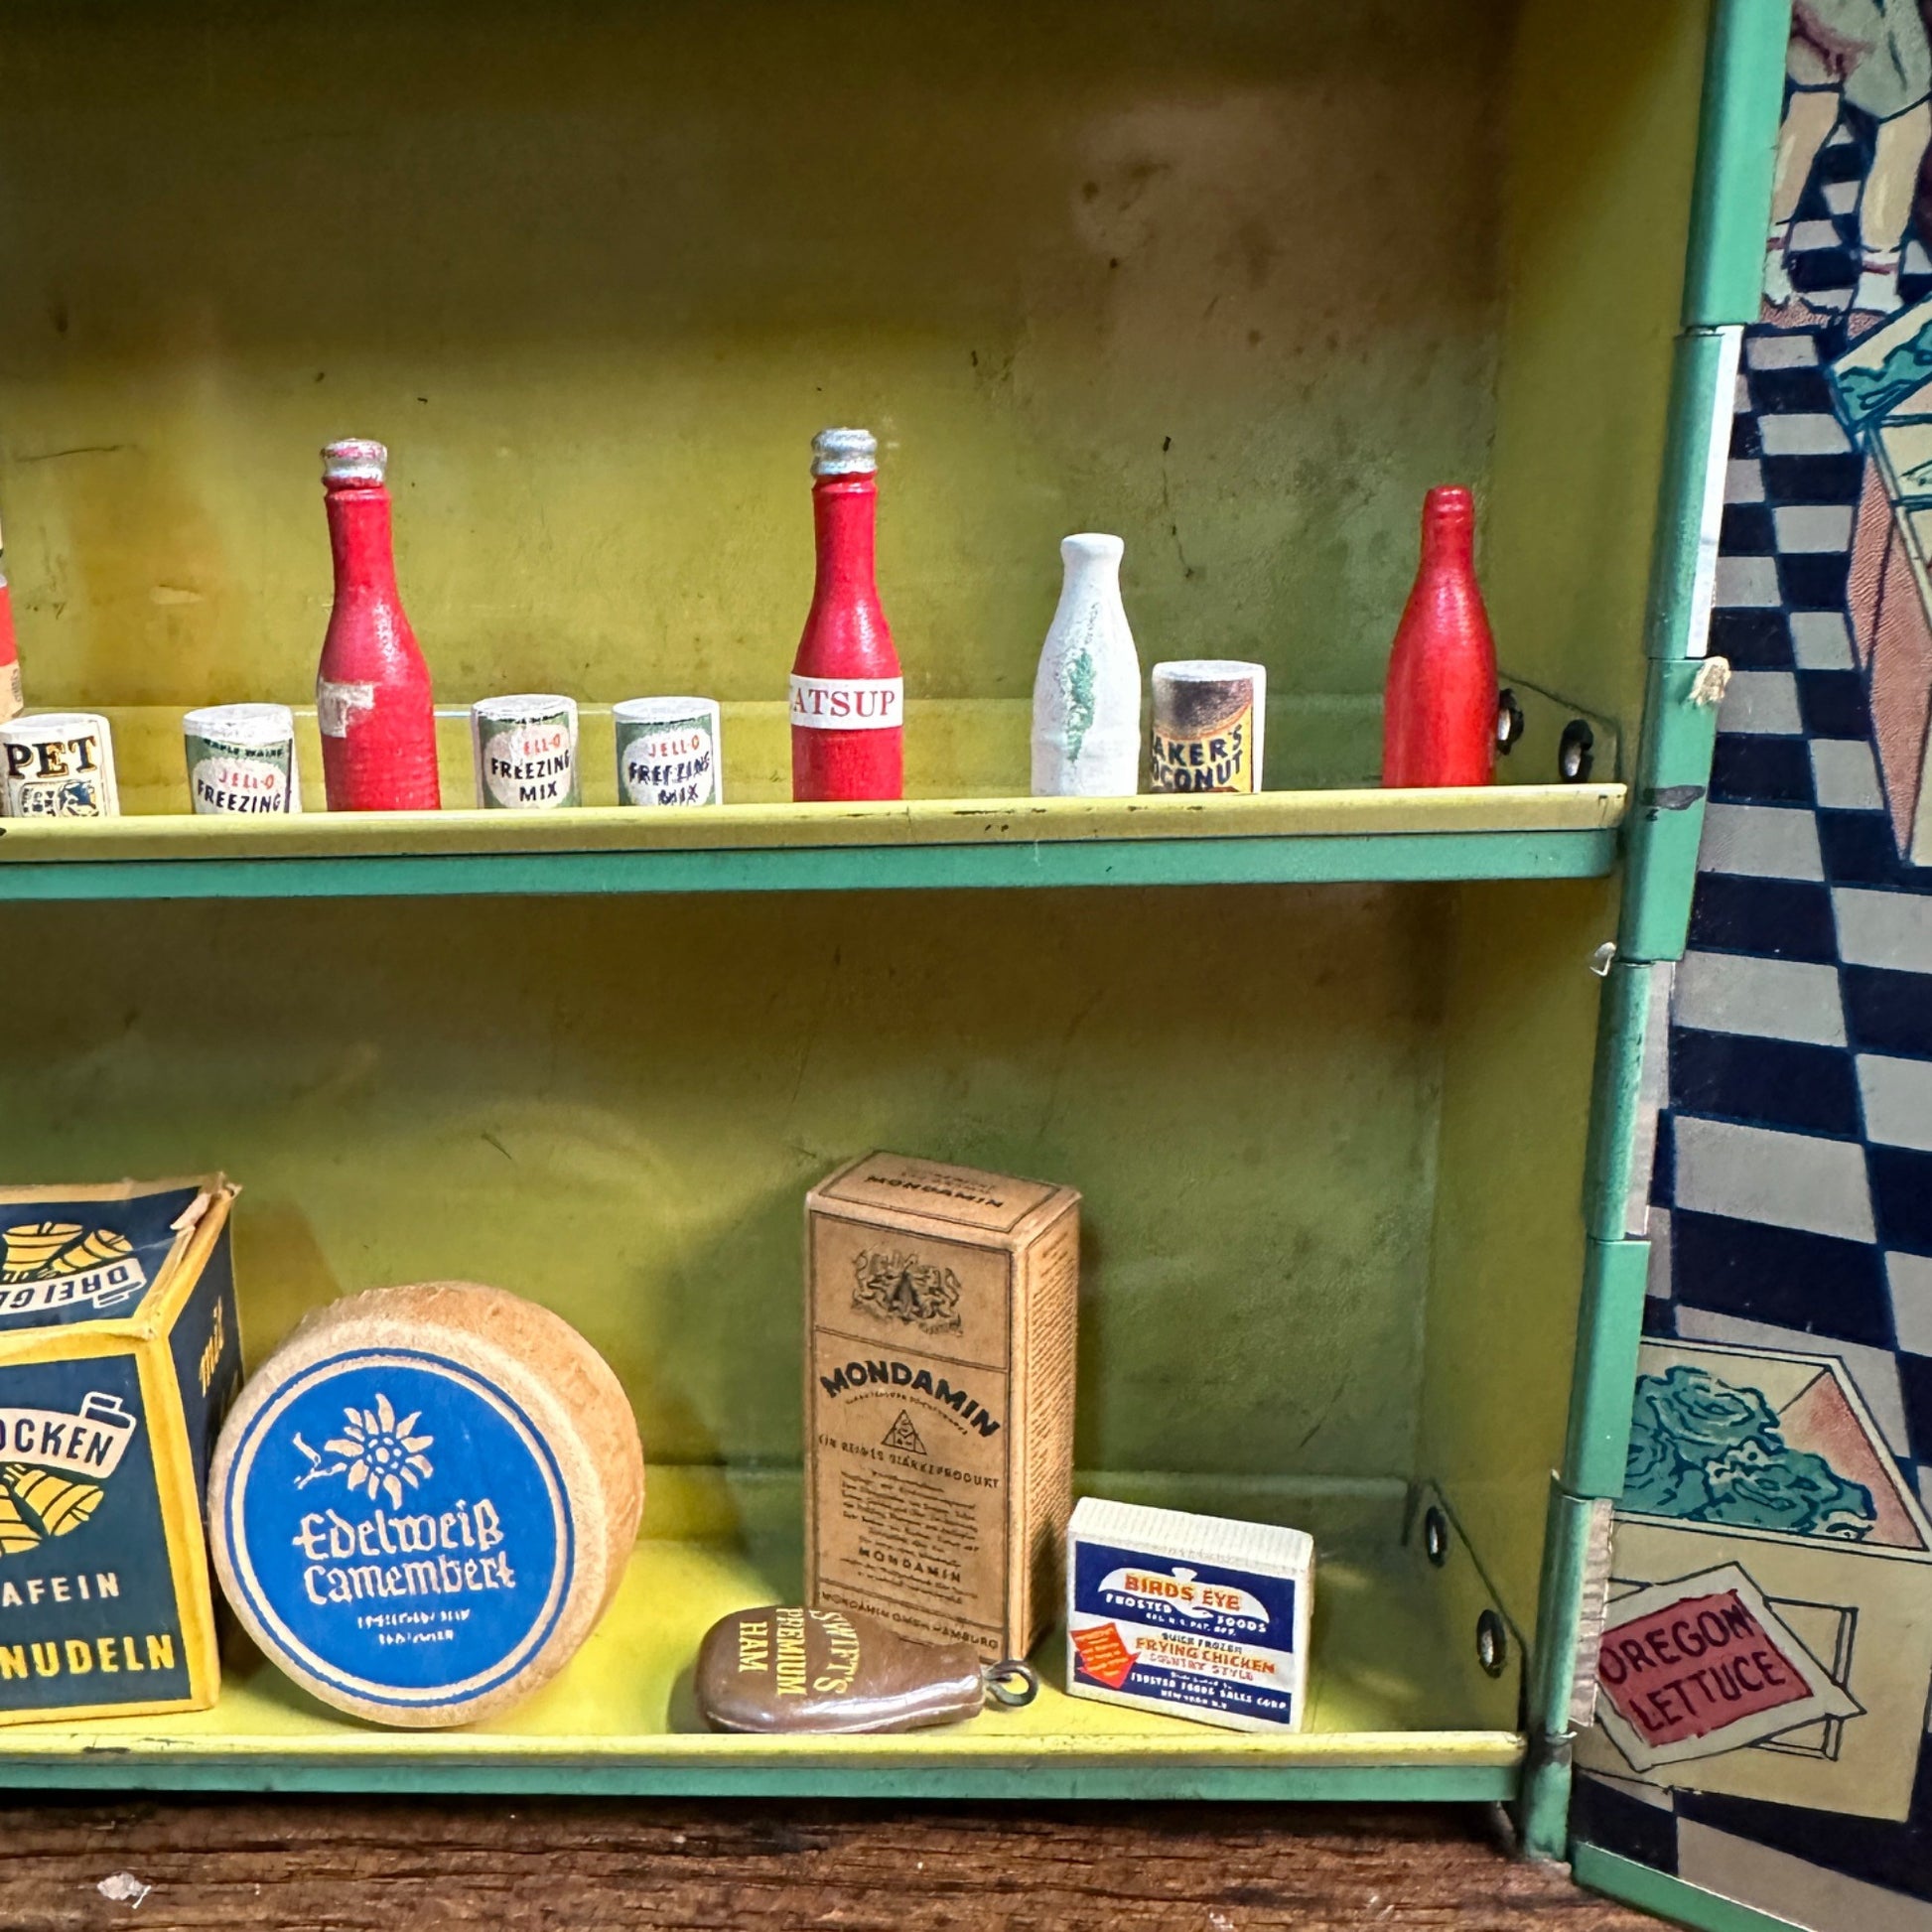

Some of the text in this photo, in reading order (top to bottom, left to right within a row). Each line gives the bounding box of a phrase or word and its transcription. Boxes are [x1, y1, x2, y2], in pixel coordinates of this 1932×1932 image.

[793, 687, 896, 718] ATSUP
[5, 735, 98, 779] PET
[491, 750, 571, 780] FREEZING
[522, 733, 562, 757] ELL-O
[1152, 723, 1243, 766] AKER'S
[518, 780, 559, 802] MIX
[1152, 749, 1243, 791] OCONUT
[198, 778, 282, 814] FREEZING
[656, 782, 700, 806] MIX
[44, 1265, 130, 1305] DREI
[819, 1359, 1002, 1439] MONDAMIN
[291, 1497, 504, 1561] Edelweiß
[303, 1549, 516, 1606] Camembert
[858, 1546, 962, 1584] MONDAMIN
[1123, 1573, 1241, 1611] BIRDS EYE
[0, 1633, 176, 1680] NUDELN
[738, 1620, 769, 1673] HAM
[774, 1606, 809, 1697] PREMIUM
[1134, 1636, 1200, 1660] FRYING
[1201, 1648, 1277, 1675] CHICKEN
[1598, 1601, 1757, 1686] OREGON
[1628, 1650, 1787, 1732] LETTUCE
